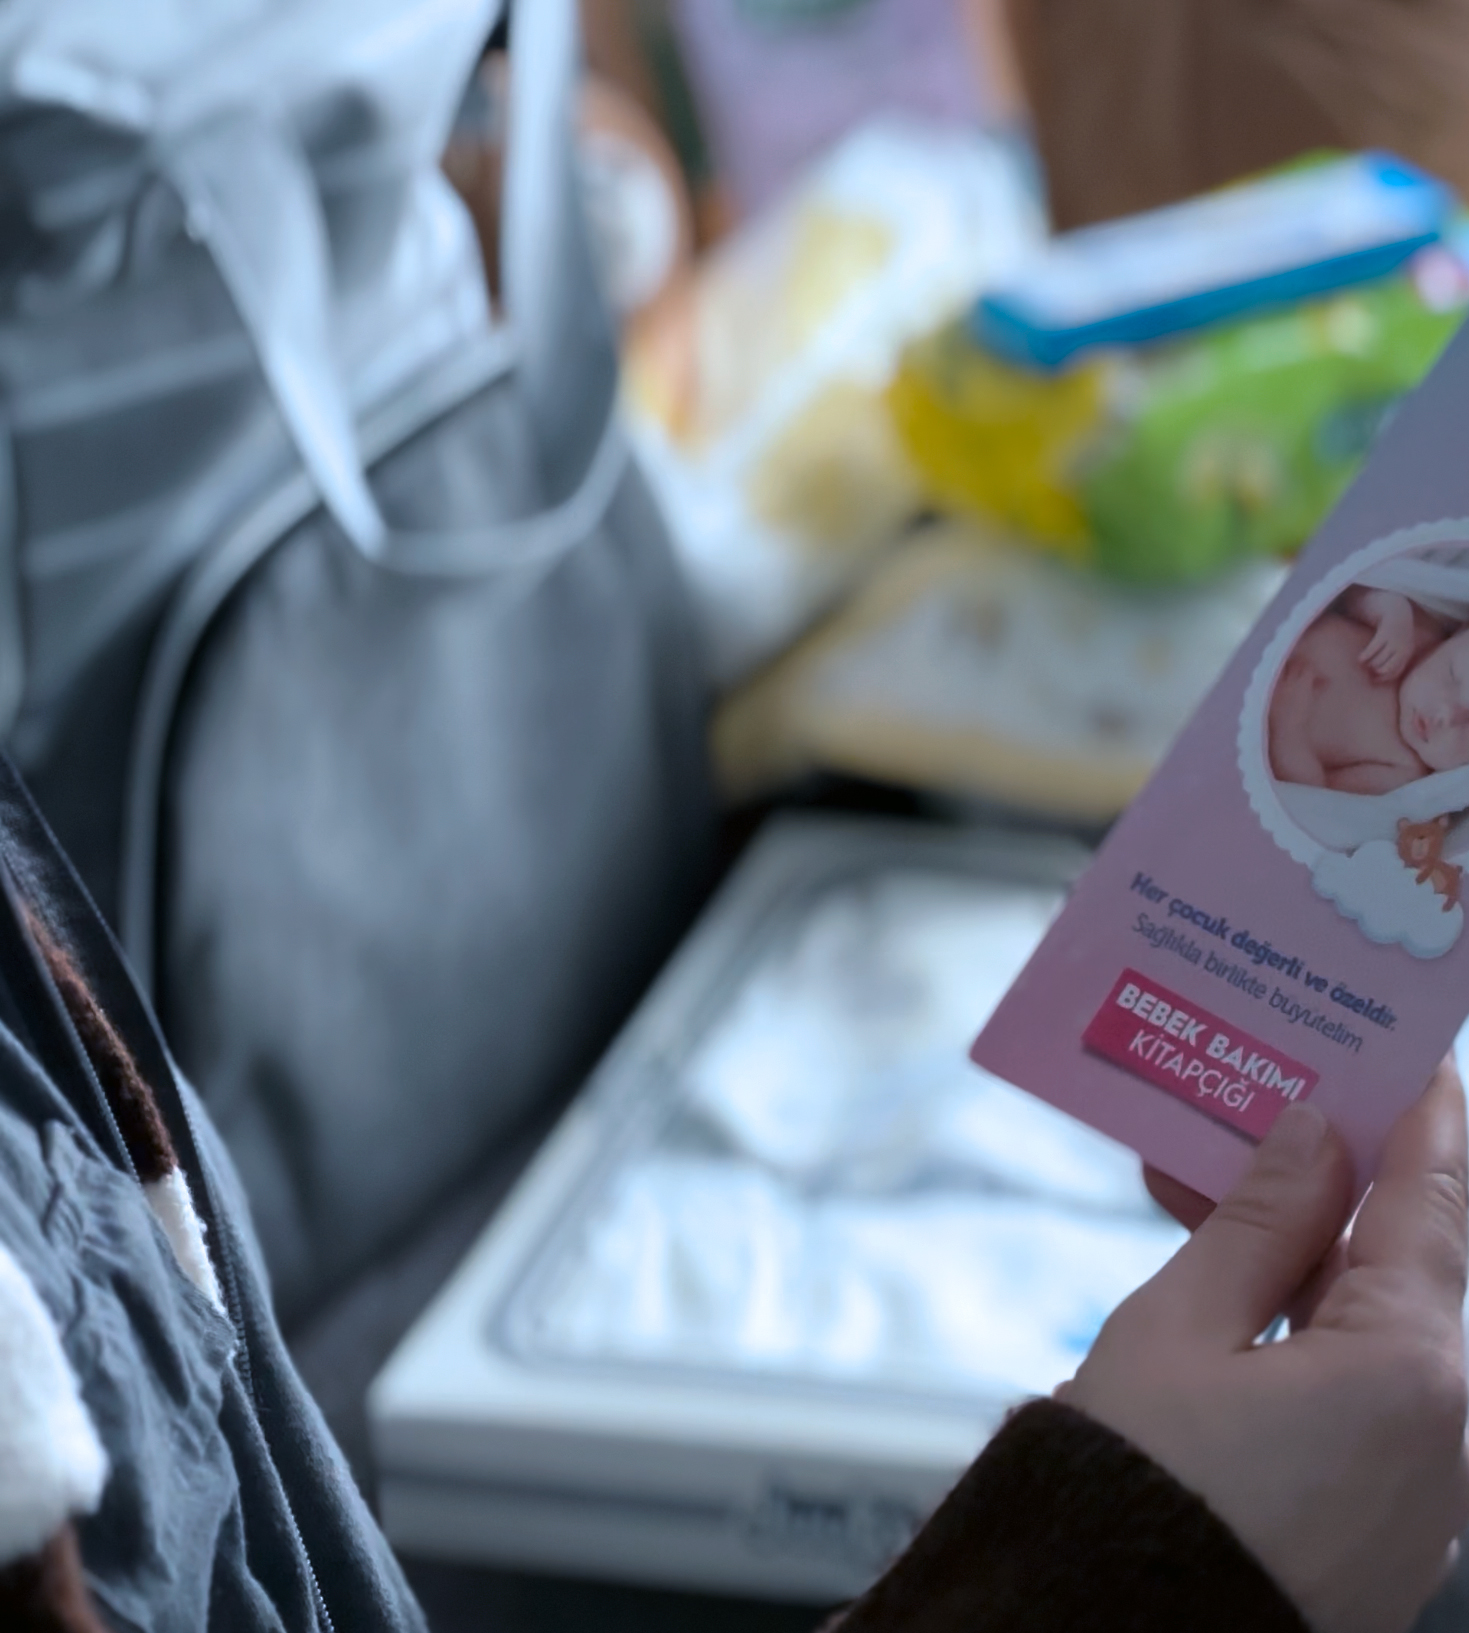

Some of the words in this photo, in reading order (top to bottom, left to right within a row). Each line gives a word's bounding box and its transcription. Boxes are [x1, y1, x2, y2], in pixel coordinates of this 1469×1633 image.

[1130, 871, 1169, 904] Her
[1168, 898, 1231, 940] çocuk
[1230, 929, 1305, 980] değerli
[1304, 970, 1329, 993] ve
[1131, 912, 1202, 965] Sağlıkla
[1203, 949, 1268, 1000] birlikte
[1115, 982, 1208, 1047] BEBEK
[1205, 1032, 1306, 1101] BAKIMI
[1128, 1028, 1256, 1113] KİTAPÇIĞI
